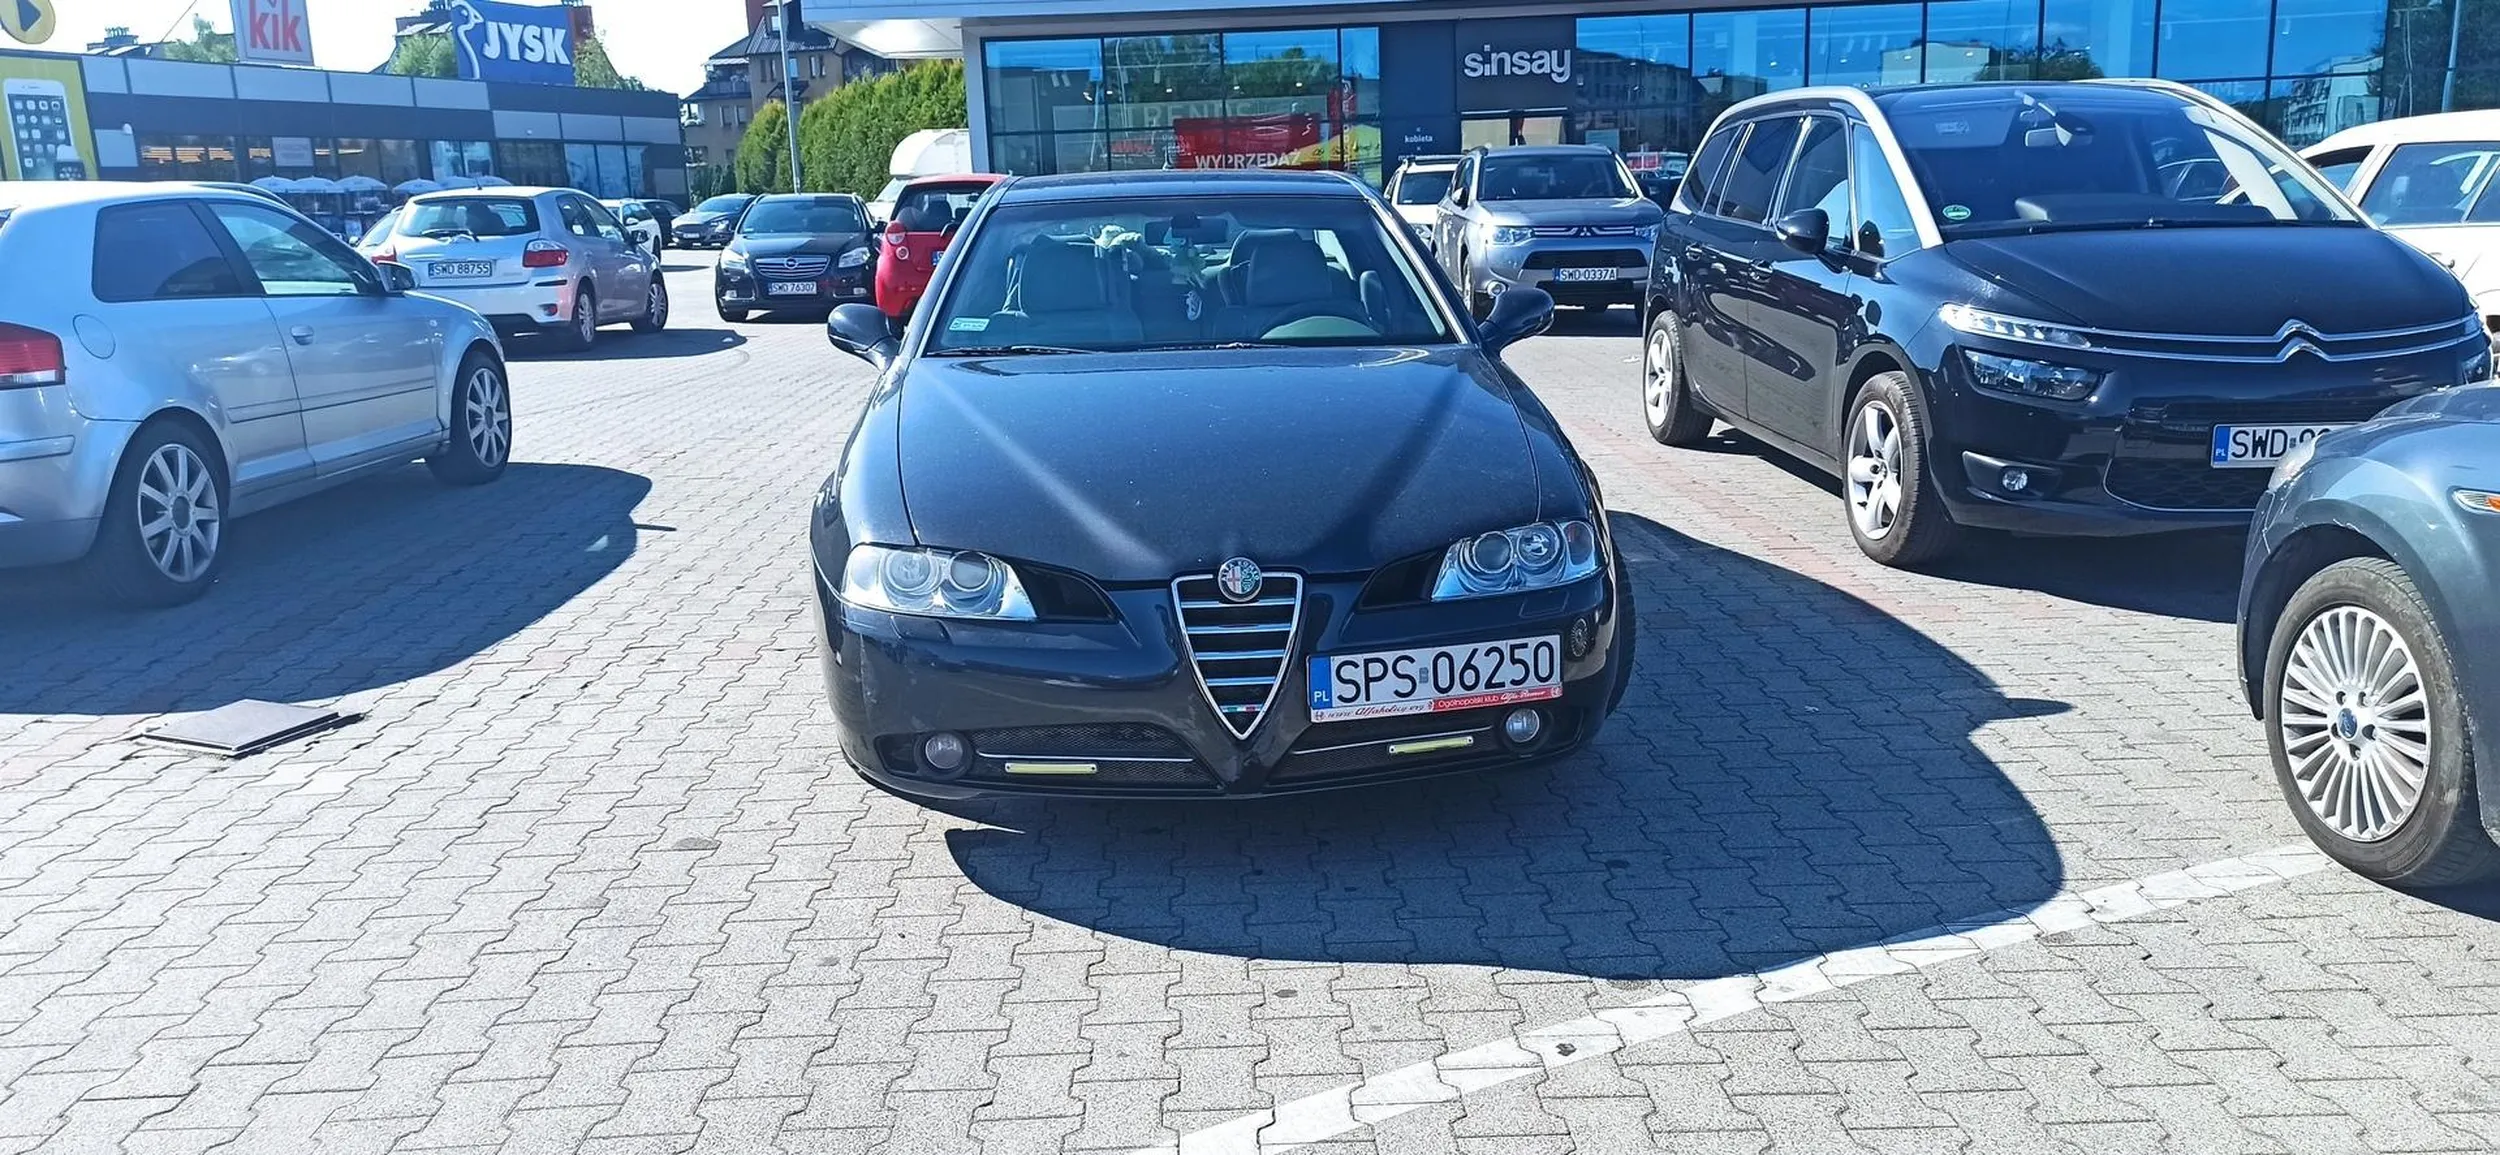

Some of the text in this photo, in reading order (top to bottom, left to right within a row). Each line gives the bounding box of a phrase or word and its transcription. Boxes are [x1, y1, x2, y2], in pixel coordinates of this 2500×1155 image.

[249, 0, 303, 52] kik
[482, 20, 571, 65] JYSK
[1463, 44, 1571, 84] sinsay
[1404, 134, 1433, 144] kobieta
[1195, 149, 1302, 169] WYPRZEDAŻ
[457, 263, 489, 274] 88755
[1561, 269, 1616, 281] SWD 0337A
[2231, 428, 2289, 459] SWD
[2215, 448, 2227, 457] PL
[1334, 640, 1555, 704] SPS 06250
[1313, 690, 1330, 702] PL
[1438, 695, 1483, 709] Ogólnopolski
[1484, 695, 1500, 703] klub
